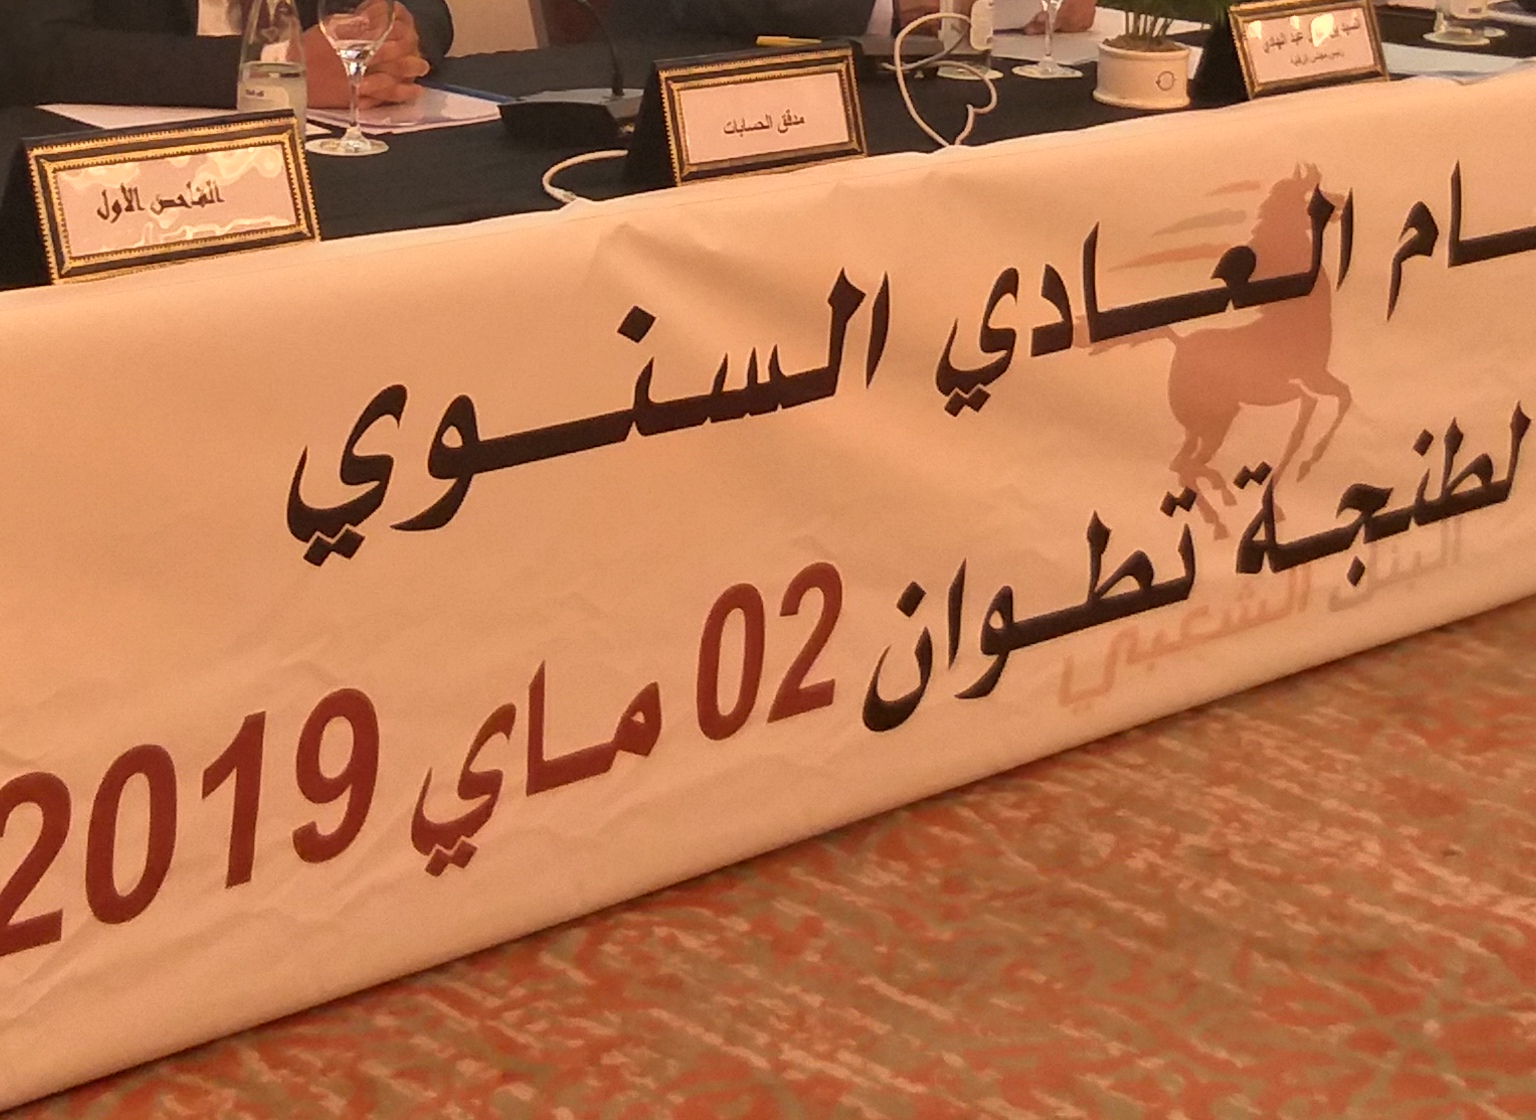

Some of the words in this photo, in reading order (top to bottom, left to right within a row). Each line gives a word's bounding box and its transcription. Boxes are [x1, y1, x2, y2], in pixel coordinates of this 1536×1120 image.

[96, 182, 146, 224] الأول
[149, 179, 225, 217] الفاحص
[722, 112, 773, 139] الحسابات
[935, 183, 1353, 416] العادي
[286, 266, 891, 568] السنوي
[1232, 402, 1533, 586] لطنجة
[695, 561, 844, 742] 02
[862, 480, 1197, 735] تطوان
[1056, 564, 1314, 716] الشعبي
[409, 660, 664, 878] ماي
